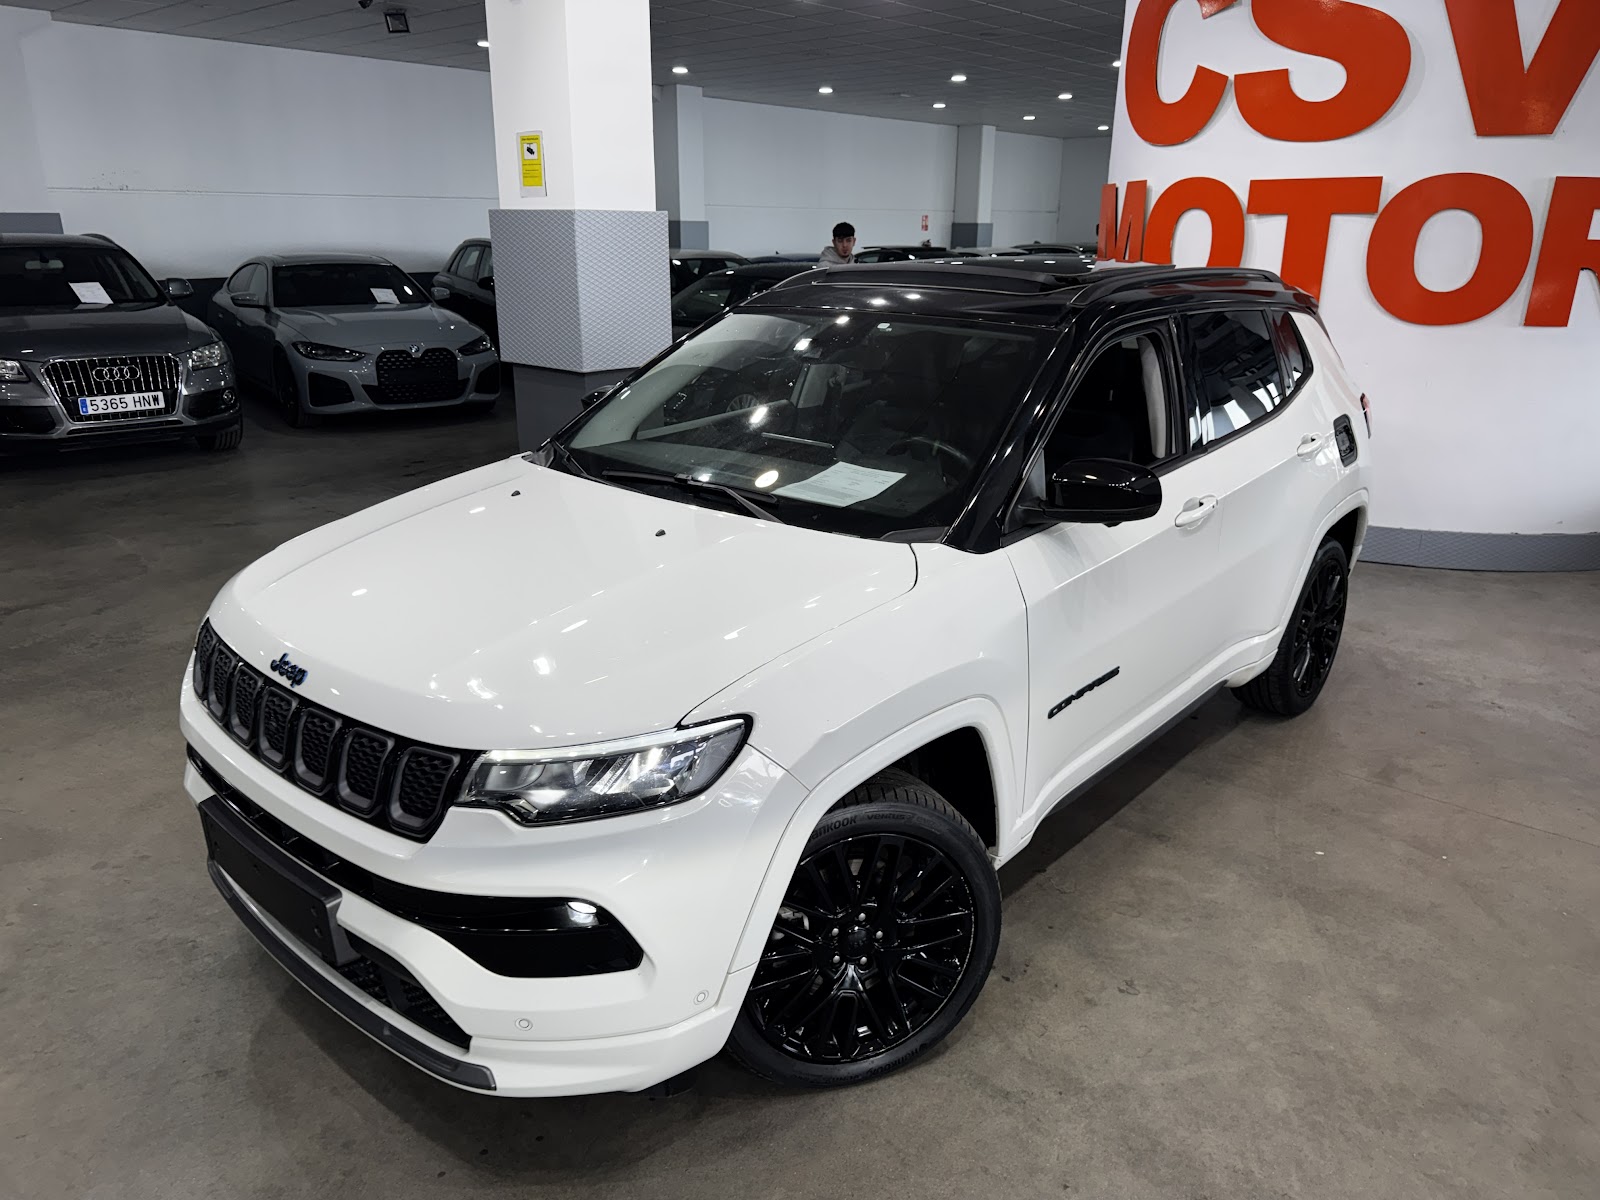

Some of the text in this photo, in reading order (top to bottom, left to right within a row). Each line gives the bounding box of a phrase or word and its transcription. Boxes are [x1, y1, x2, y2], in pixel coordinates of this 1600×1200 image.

[1125, 0, 1600, 145] CSV
[90, 395, 160, 412] 5365 HNW
[270, 653, 308, 688] Jeep
